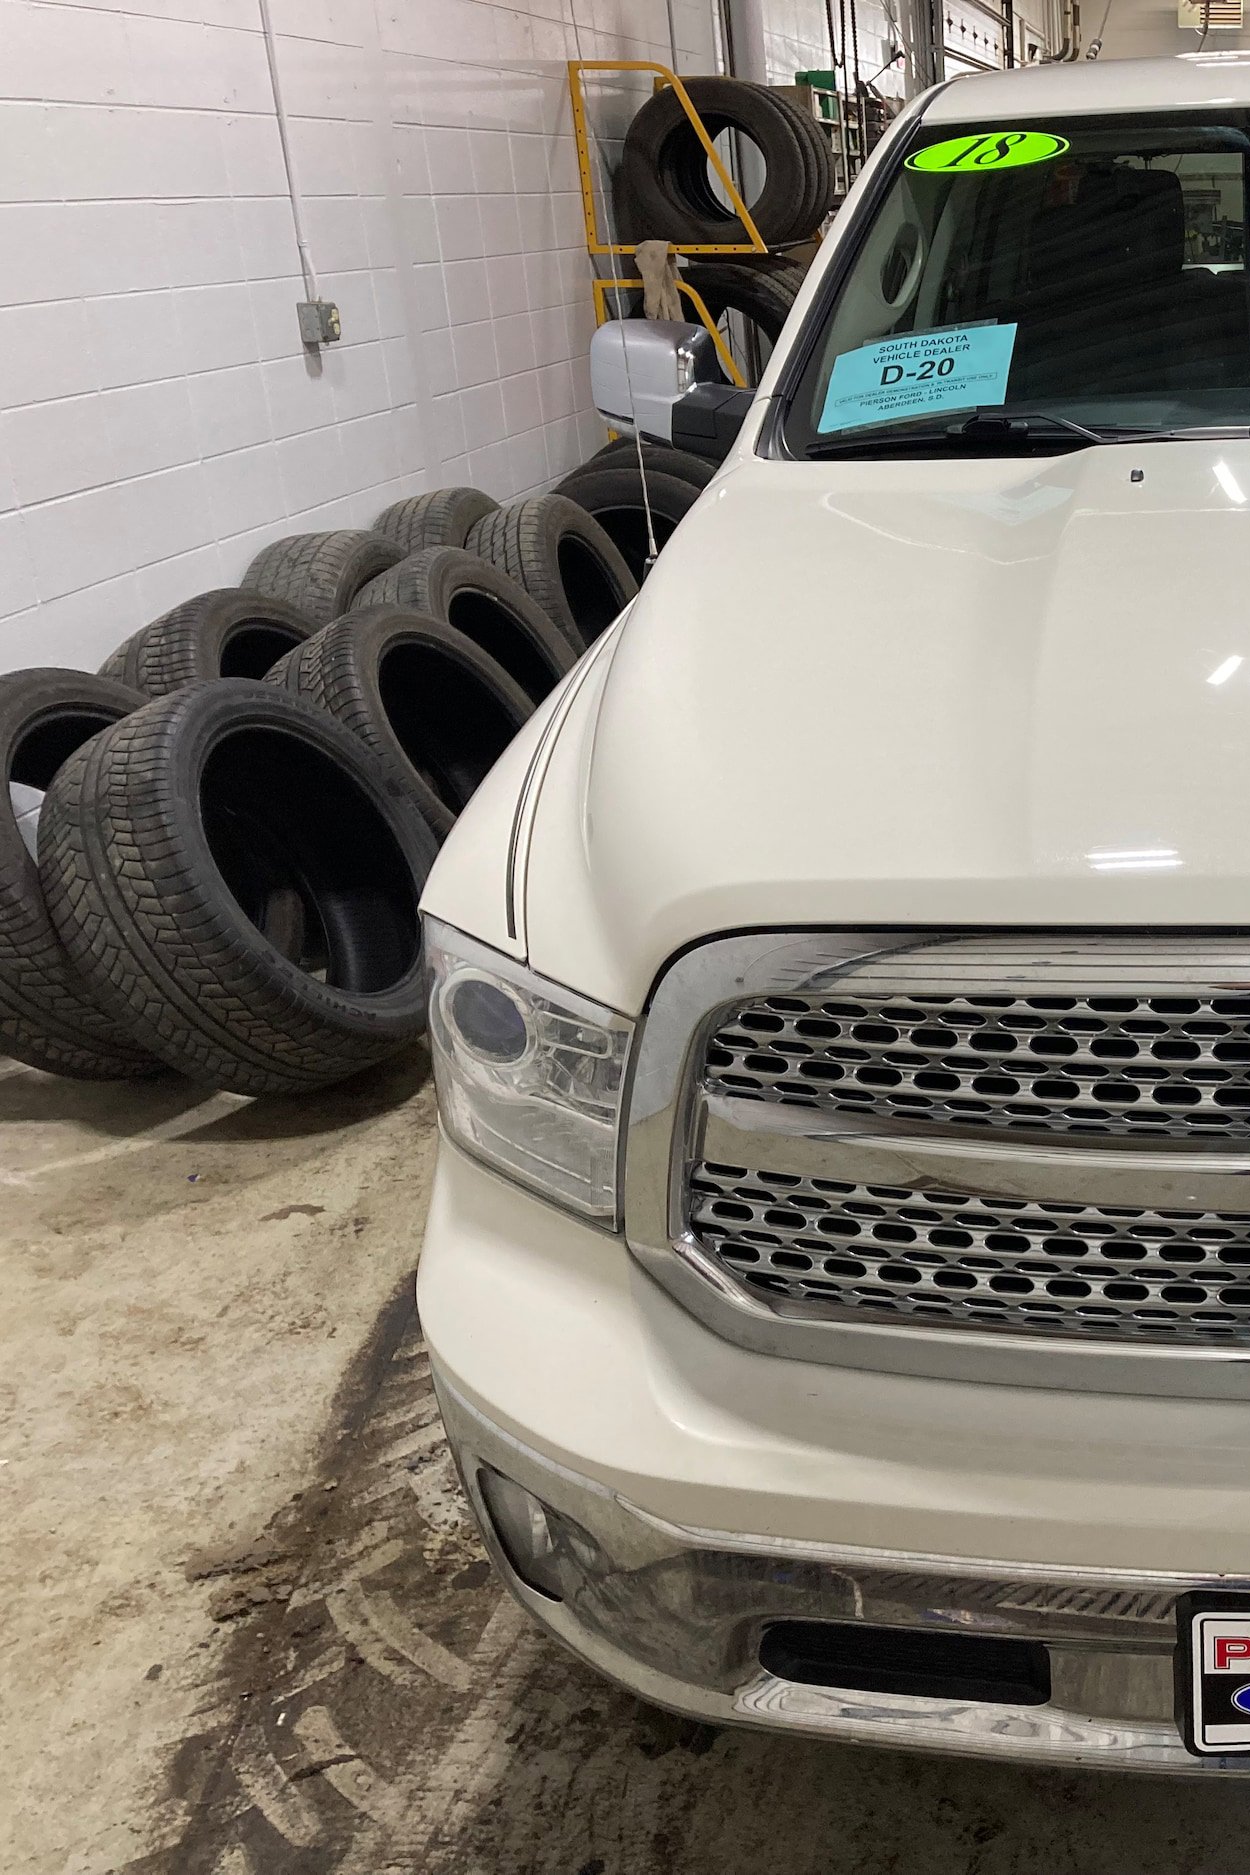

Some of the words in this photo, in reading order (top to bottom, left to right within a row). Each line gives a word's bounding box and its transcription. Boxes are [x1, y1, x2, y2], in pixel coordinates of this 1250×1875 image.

[938, 133, 1027, 168] 18
[873, 351, 921, 364] VEHICLE
[923, 343, 971, 357] DEALER
[879, 341, 918, 354] SOUTH
[920, 334, 968, 348] DAKOTA
[880, 357, 955, 386] D-20
[860, 396, 897, 407] PIERSON
[899, 391, 922, 401] FORD
[929, 384, 966, 395] LINCOLN
